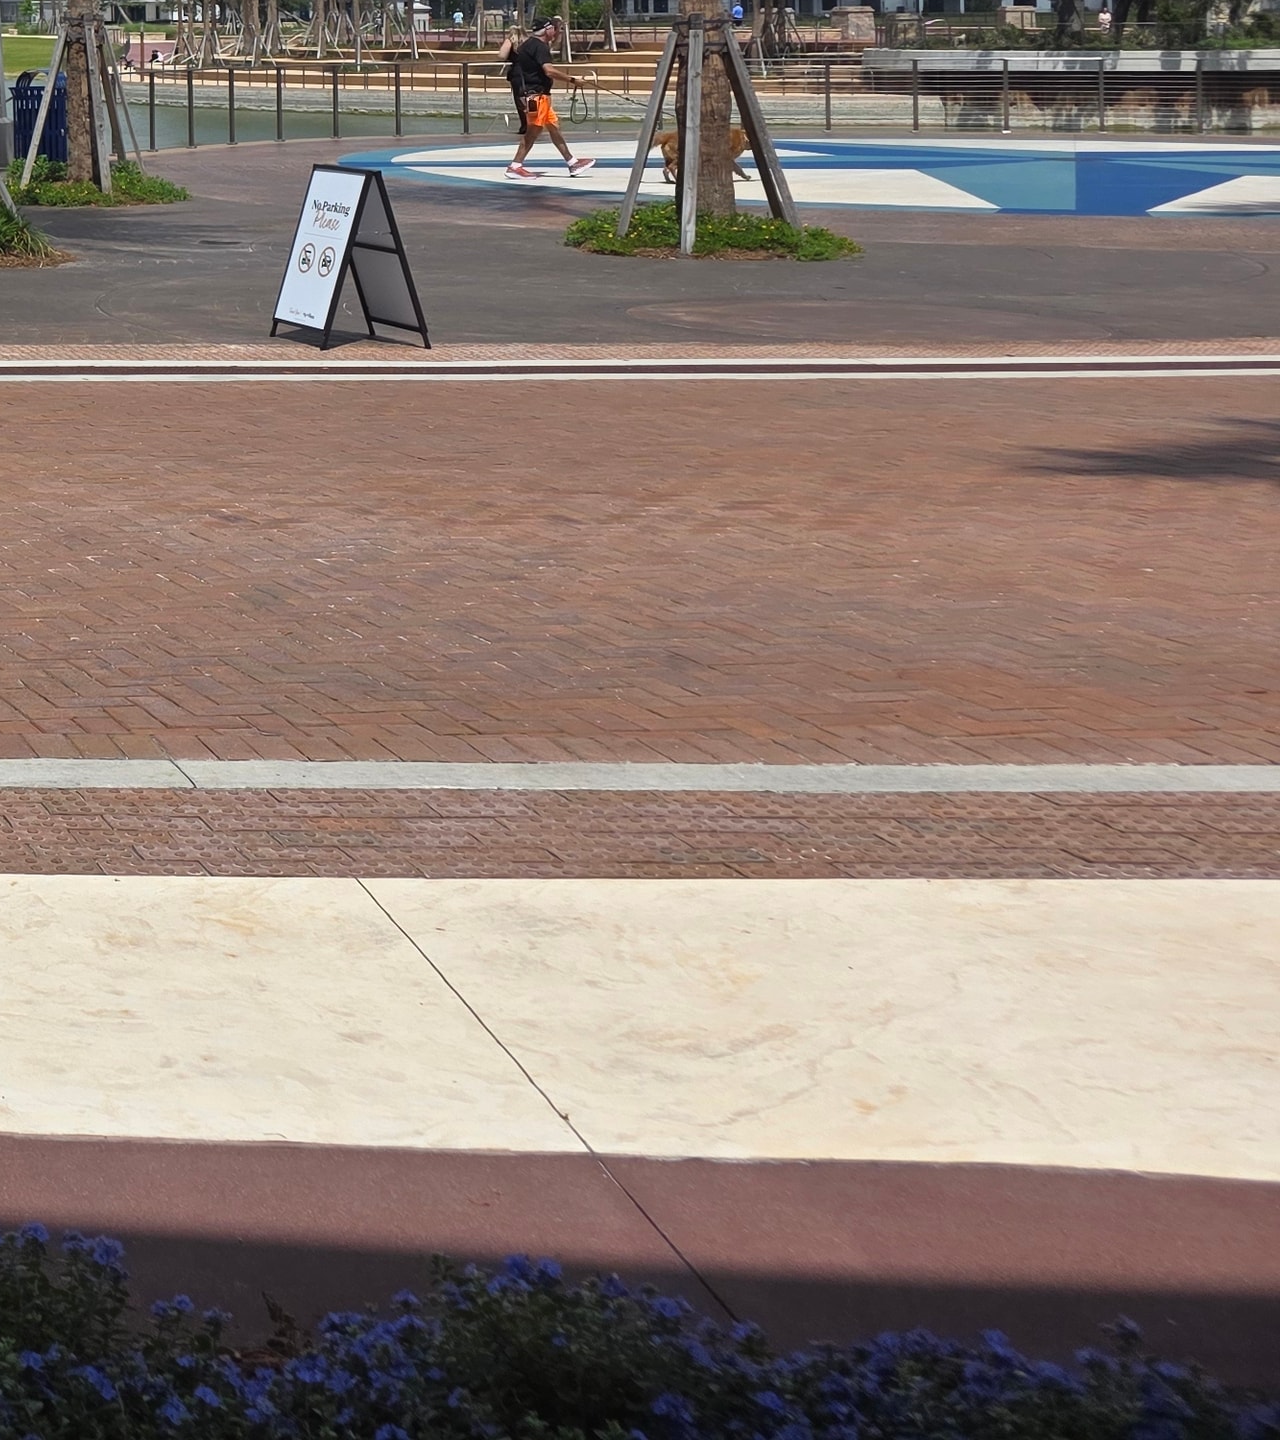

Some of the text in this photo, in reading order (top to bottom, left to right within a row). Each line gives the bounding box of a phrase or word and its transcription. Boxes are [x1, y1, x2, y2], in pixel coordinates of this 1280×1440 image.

[311, 199, 351, 218] No Parking
[312, 210, 341, 231] Please
